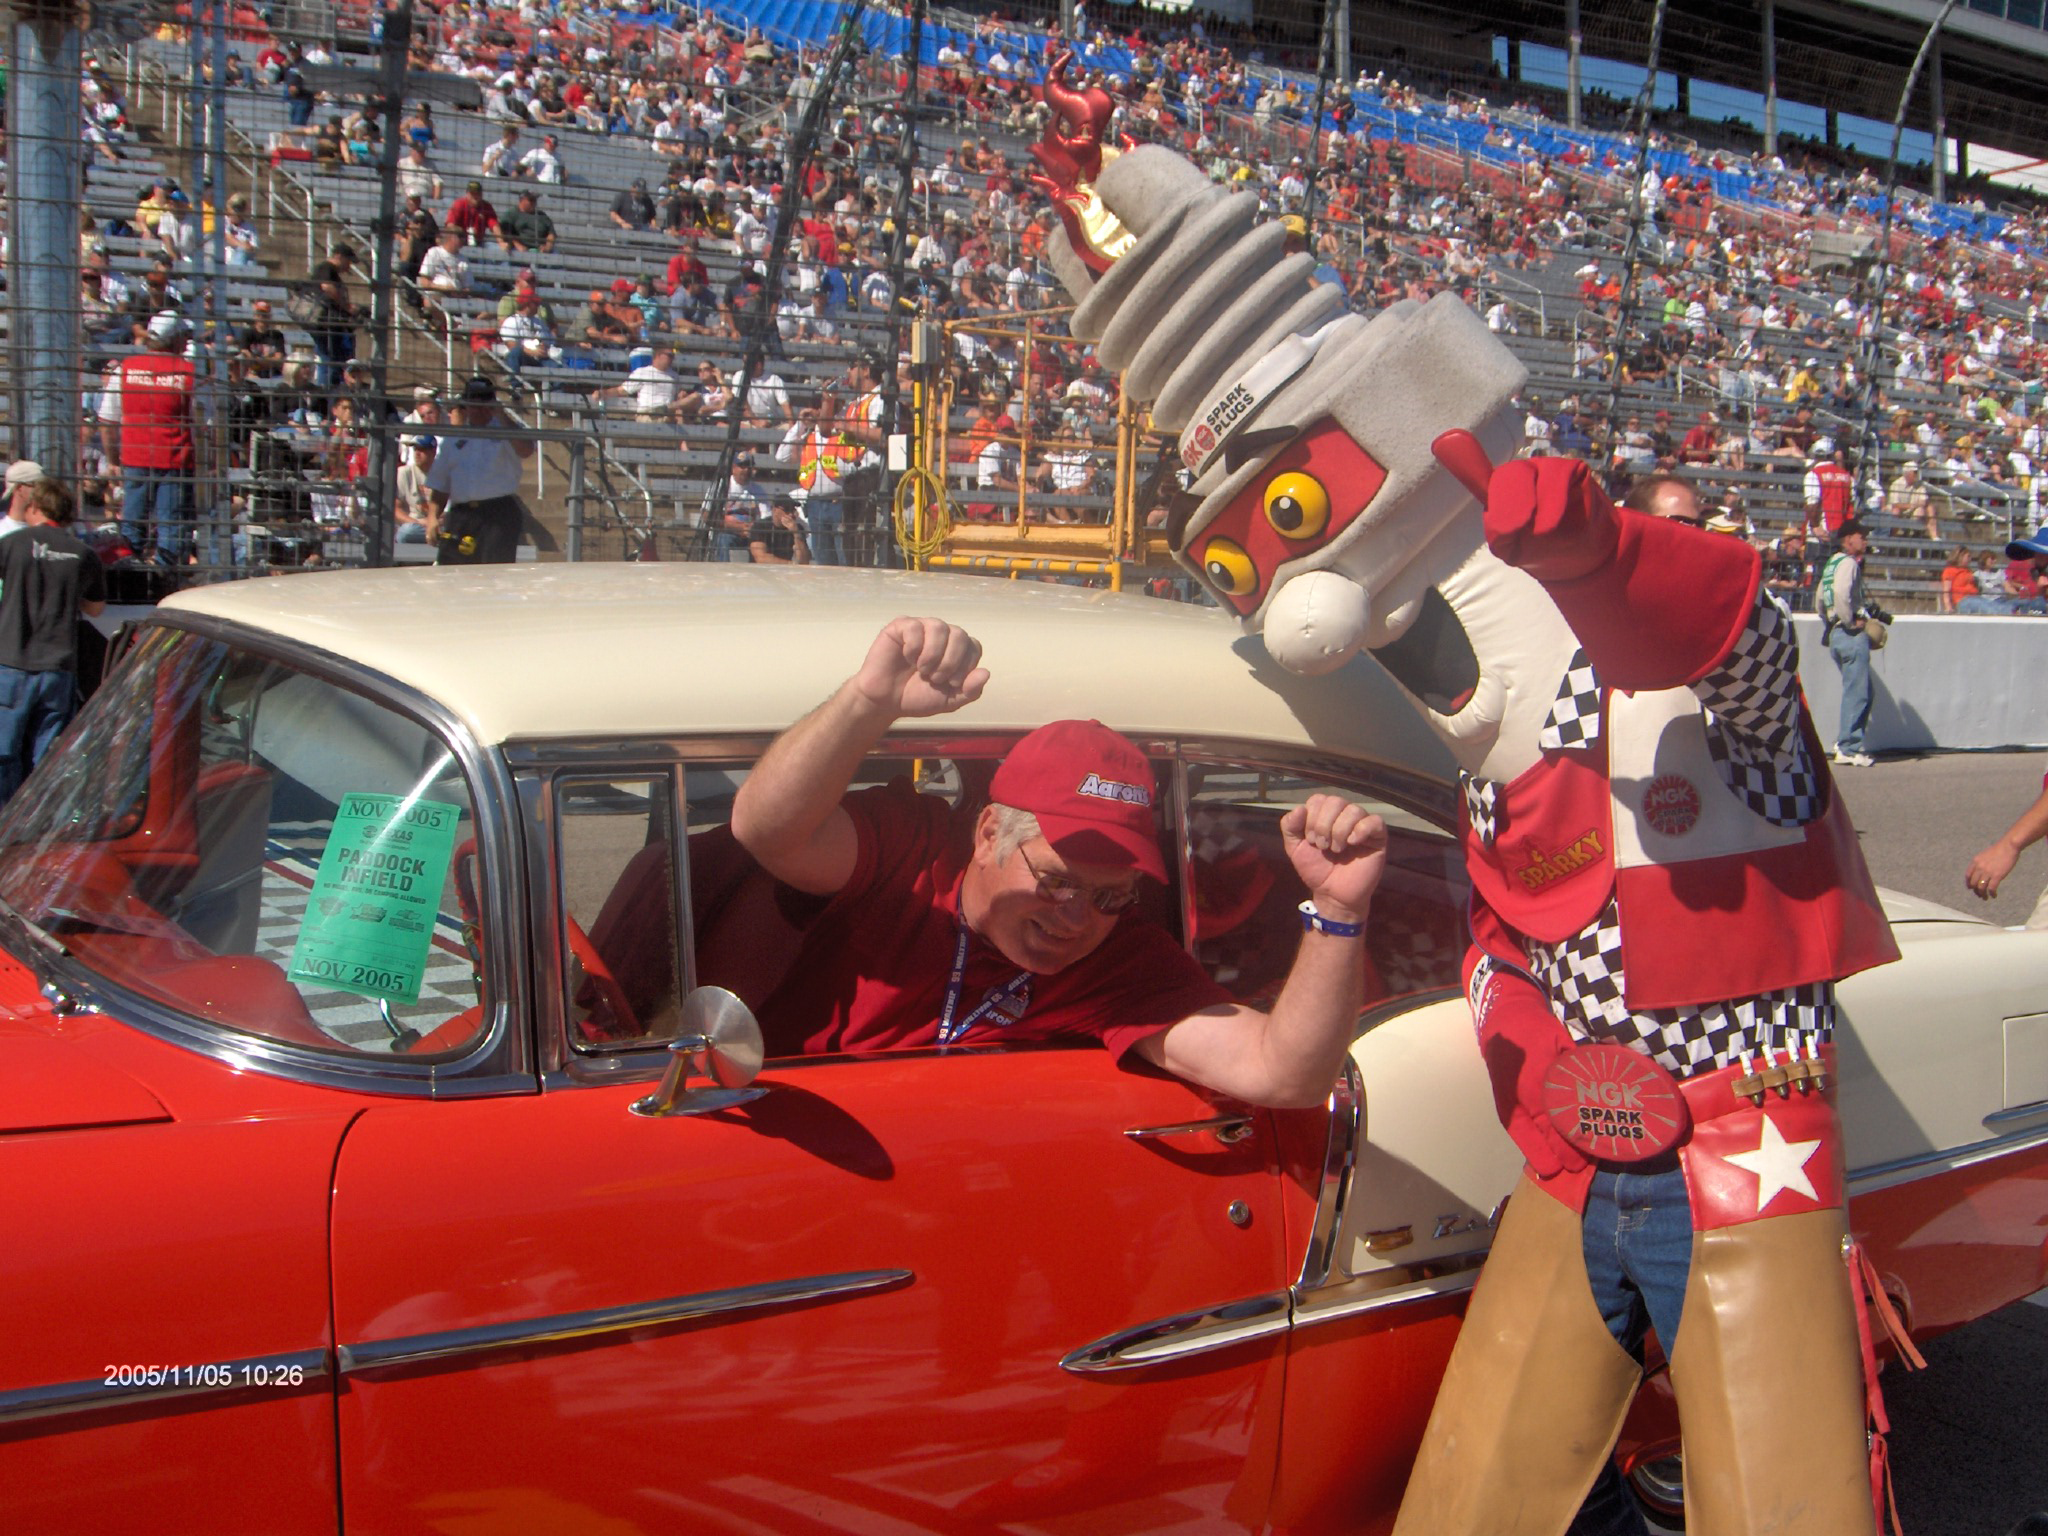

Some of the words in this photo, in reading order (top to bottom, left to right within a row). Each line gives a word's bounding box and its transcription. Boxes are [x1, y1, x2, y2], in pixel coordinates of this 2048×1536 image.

[1207, 383, 1247, 426] SPARK
[1213, 393, 1254, 436] PLUGS
[1182, 440, 1203, 468] GK
[347, 801, 387, 818] NOV
[1651, 788, 1690, 806] NGK
[338, 847, 427, 876] PADDOCK
[1518, 831, 1604, 889] SPARKY
[341, 866, 413, 891] INFIELD
[302, 958, 347, 980] NOV
[351, 967, 405, 992] 2005
[1575, 1080, 1645, 1108] NGK
[1579, 1107, 1643, 1124] SPARK
[1580, 1122, 1644, 1140] PLUGS
